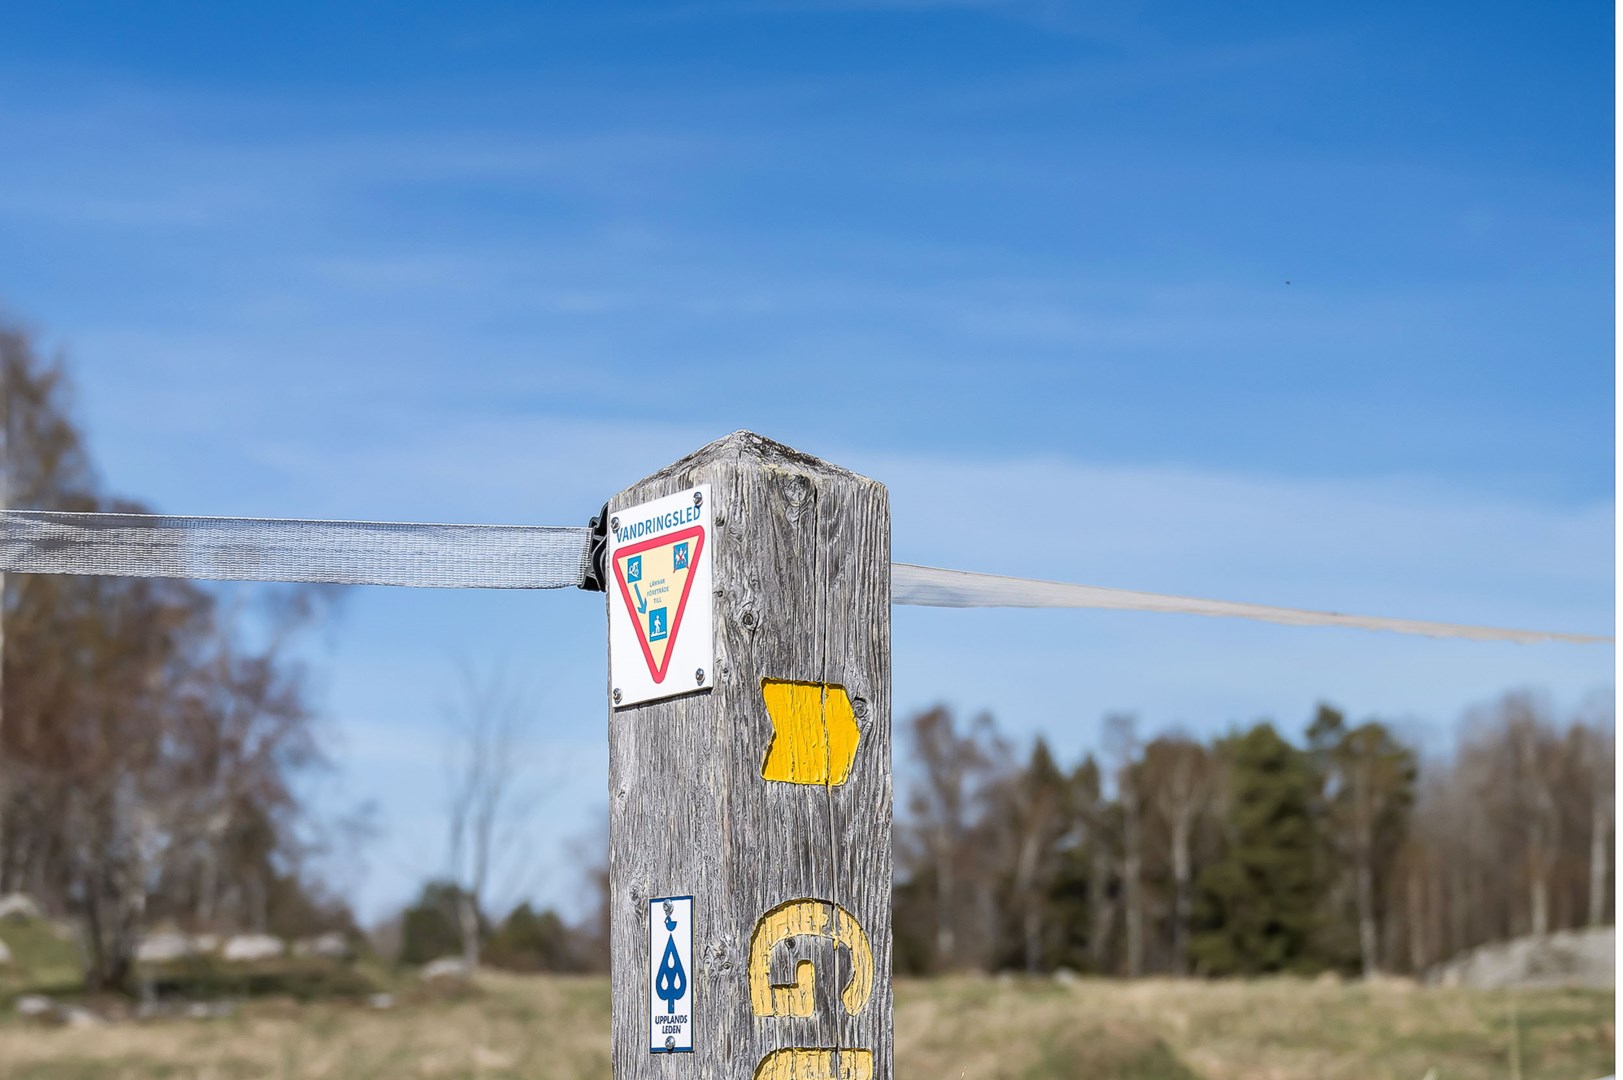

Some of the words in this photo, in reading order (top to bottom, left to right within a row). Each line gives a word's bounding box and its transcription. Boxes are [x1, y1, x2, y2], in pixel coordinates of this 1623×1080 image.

[617, 505, 701, 543] VANDRINGSLED
[655, 1014, 688, 1025] UPPLANDS
[662, 1025, 681, 1034] LEDEN
